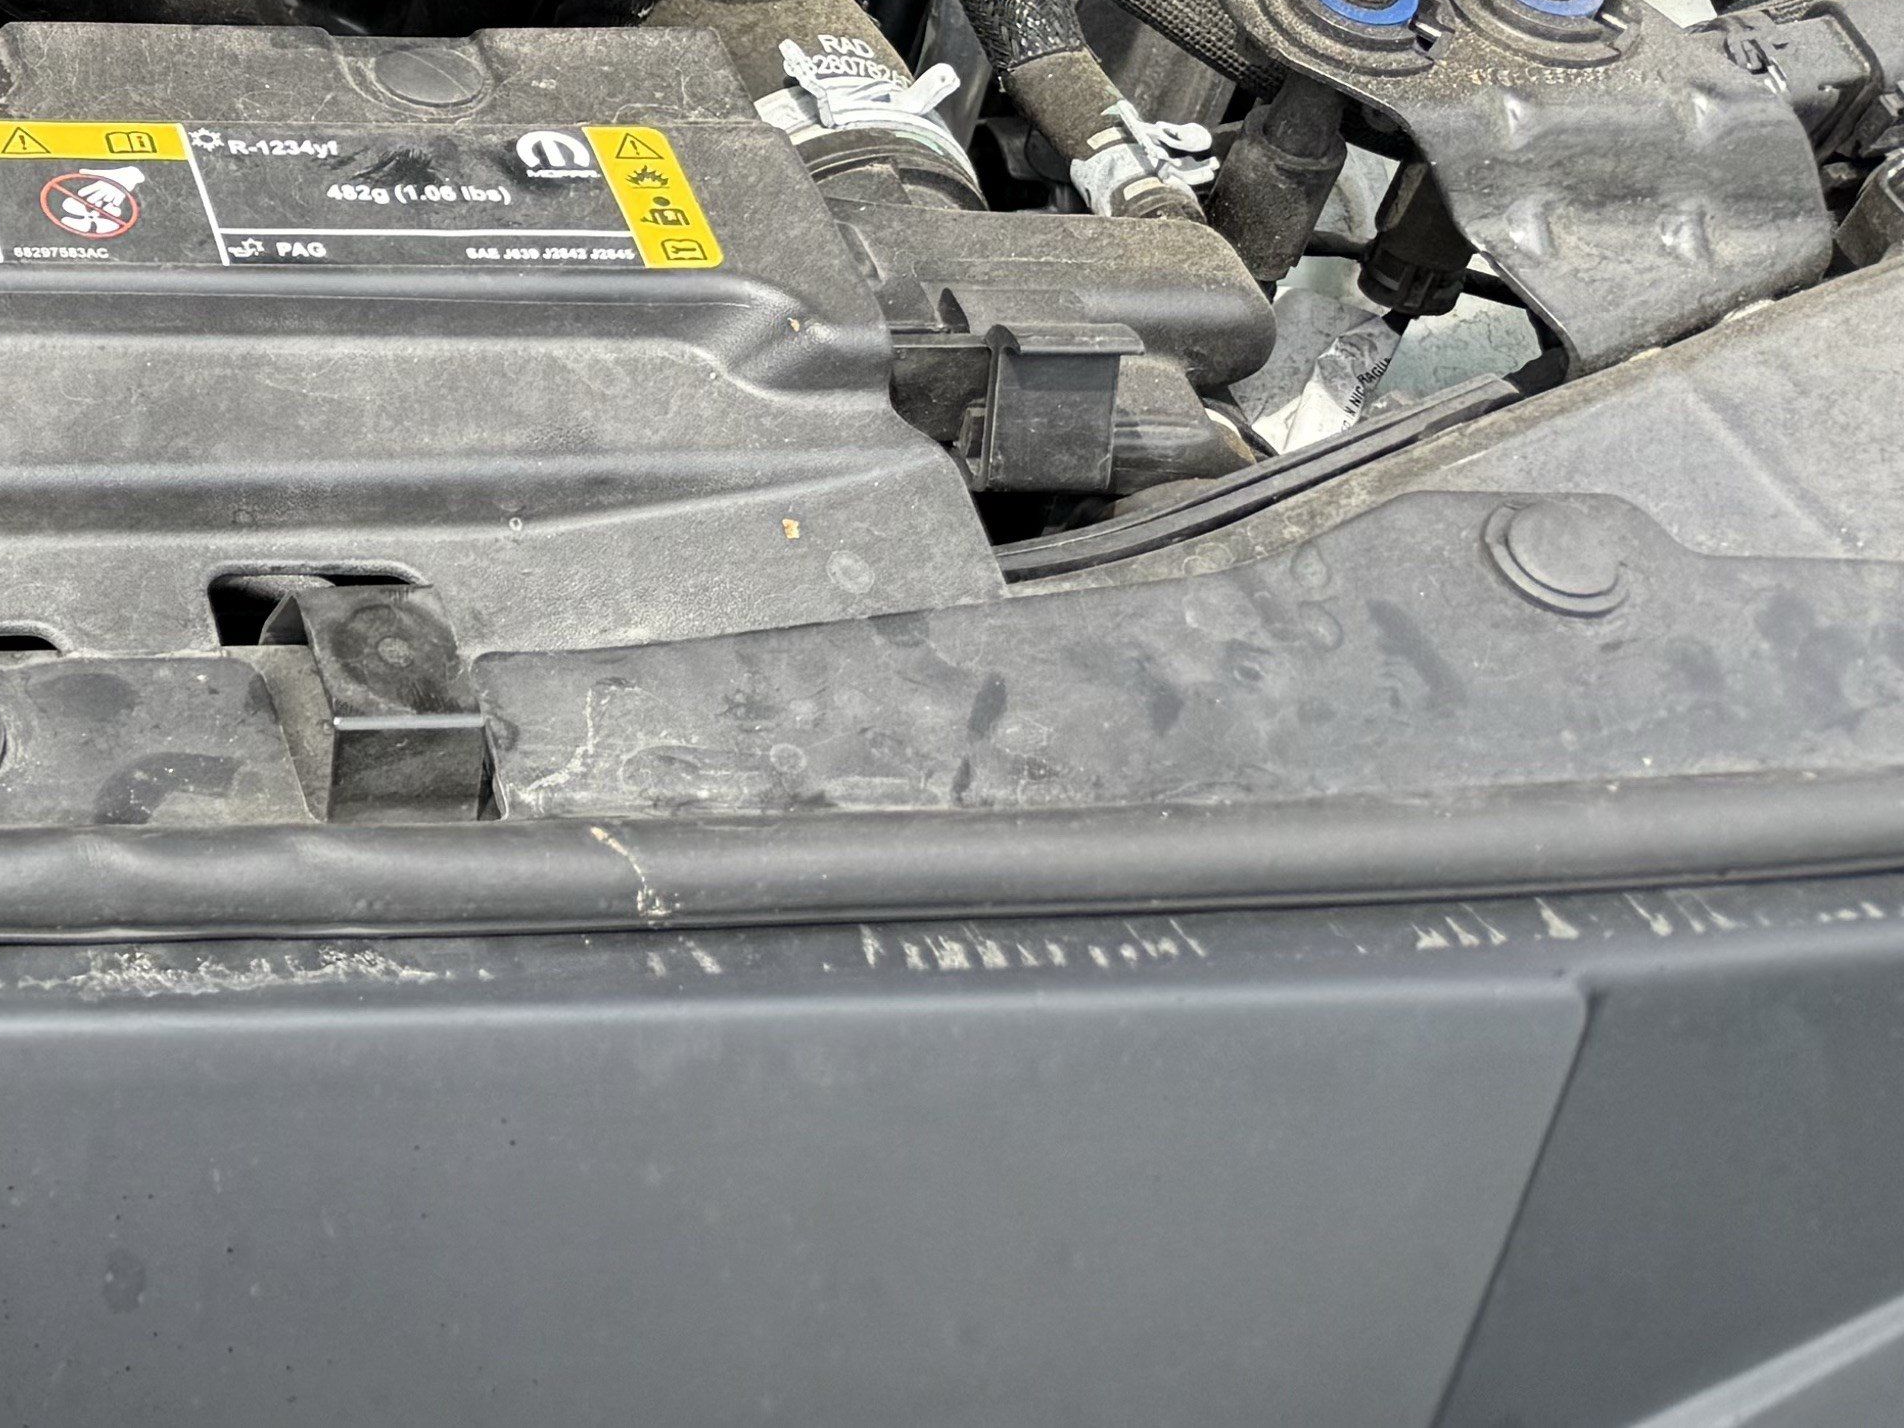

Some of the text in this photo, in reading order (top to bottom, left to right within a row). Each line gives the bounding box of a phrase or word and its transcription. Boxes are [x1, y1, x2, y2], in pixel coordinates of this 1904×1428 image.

[817, 35, 874, 58] RAD
[326, 184, 390, 204] 482g
[461, 185, 511, 205] lbs)
[275, 242, 327, 257] PAG
[466, 248, 500, 259] SAE
